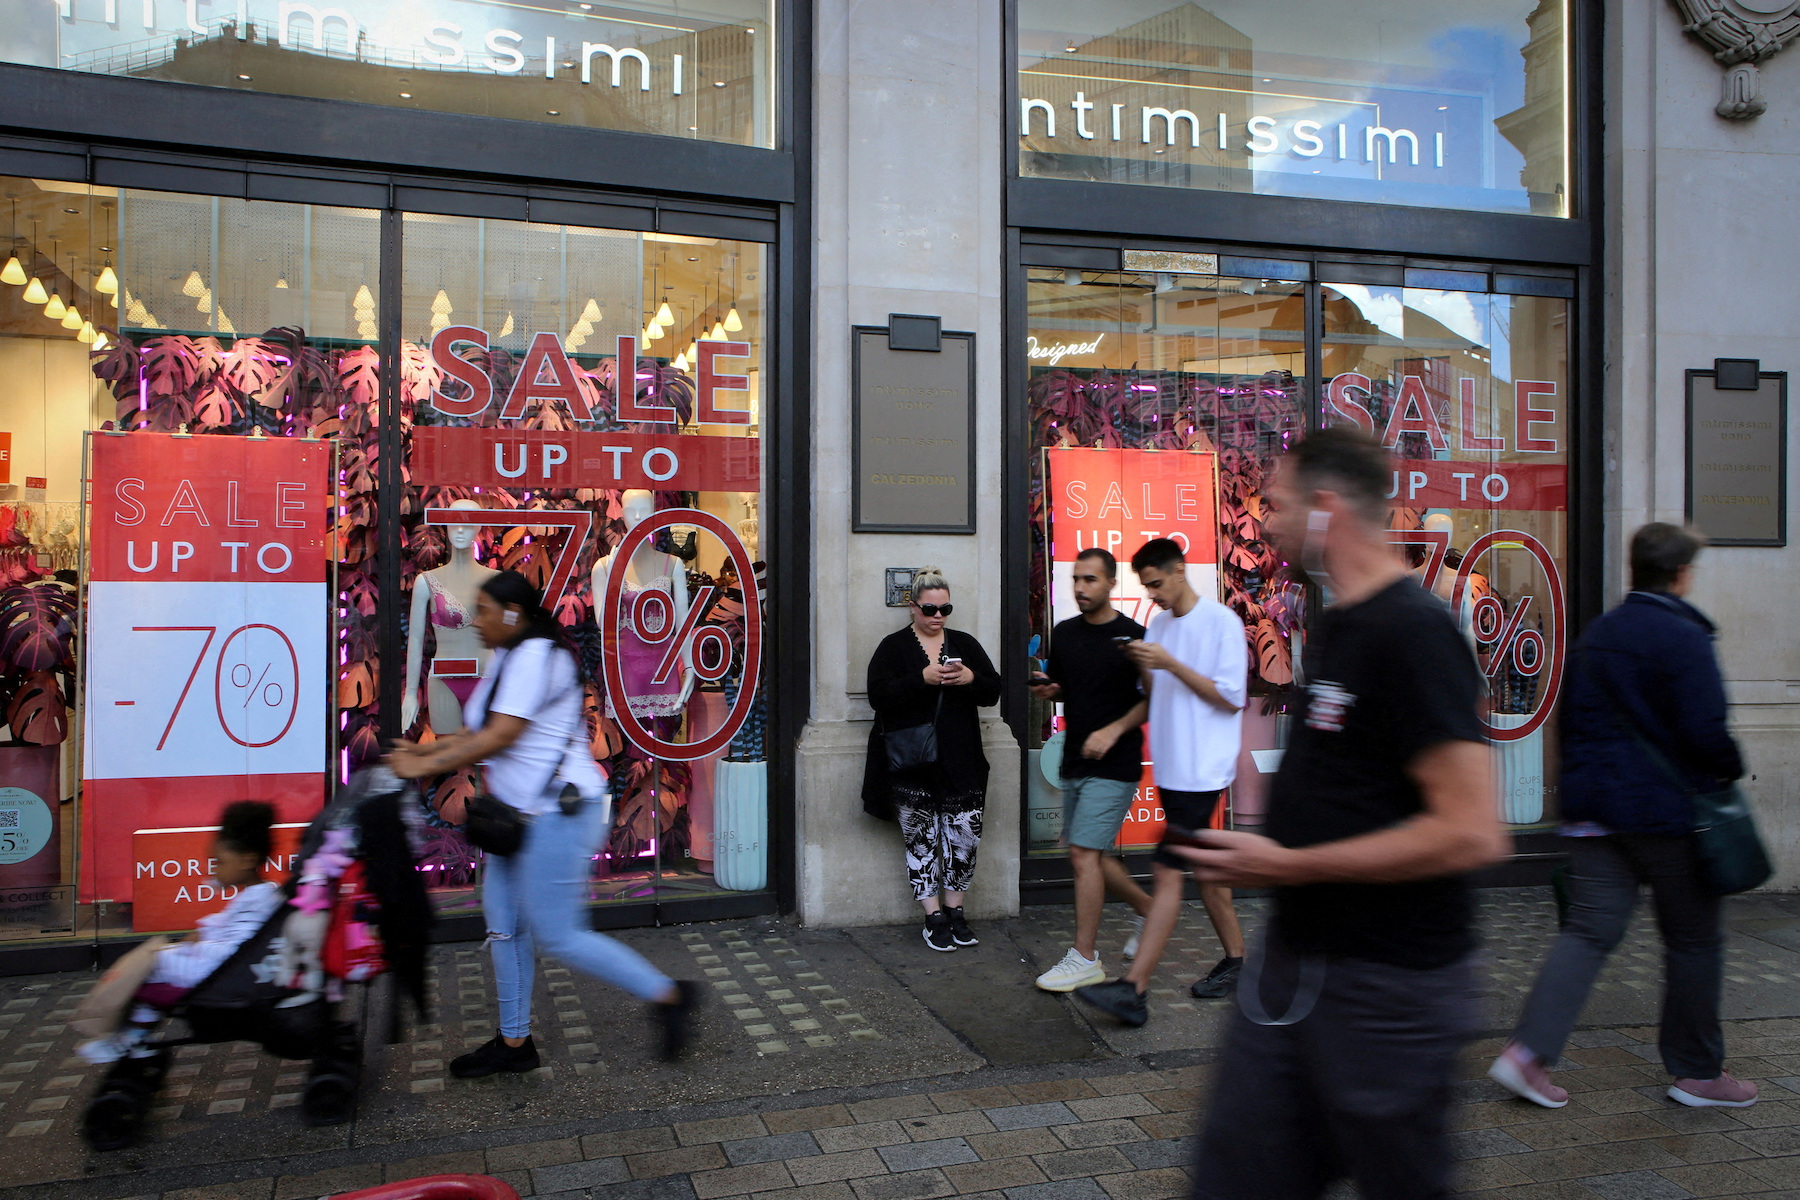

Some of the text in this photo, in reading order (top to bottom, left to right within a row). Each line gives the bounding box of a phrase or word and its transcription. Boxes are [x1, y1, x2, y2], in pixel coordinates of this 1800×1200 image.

[61, 0, 681, 95] timssimi
[1021, 91, 1444, 168] ntimissimi
[430, 325, 752, 426] SALE
[1328, 372, 1557, 453] SALE
[495, 442, 679, 481] UP TO
[870, 473, 958, 486] CALZEDONIA
[1452, 471, 1510, 502] TO
[114, 478, 306, 529] SALE
[1066, 480, 1198, 521] SALE
[1076, 530, 1123, 555] UP
[127, 541, 293, 574] UP TO
[1519, 776, 1541, 785] CUPS
[1036, 811, 1060, 820] CLICK
[1122, 807, 1167, 823] ADD
[706, 831, 735, 841] CUPS
[136, 857, 219, 880] MORE
[9, 891, 66, 903] COLLECT
[174, 884, 240, 904] ADD
